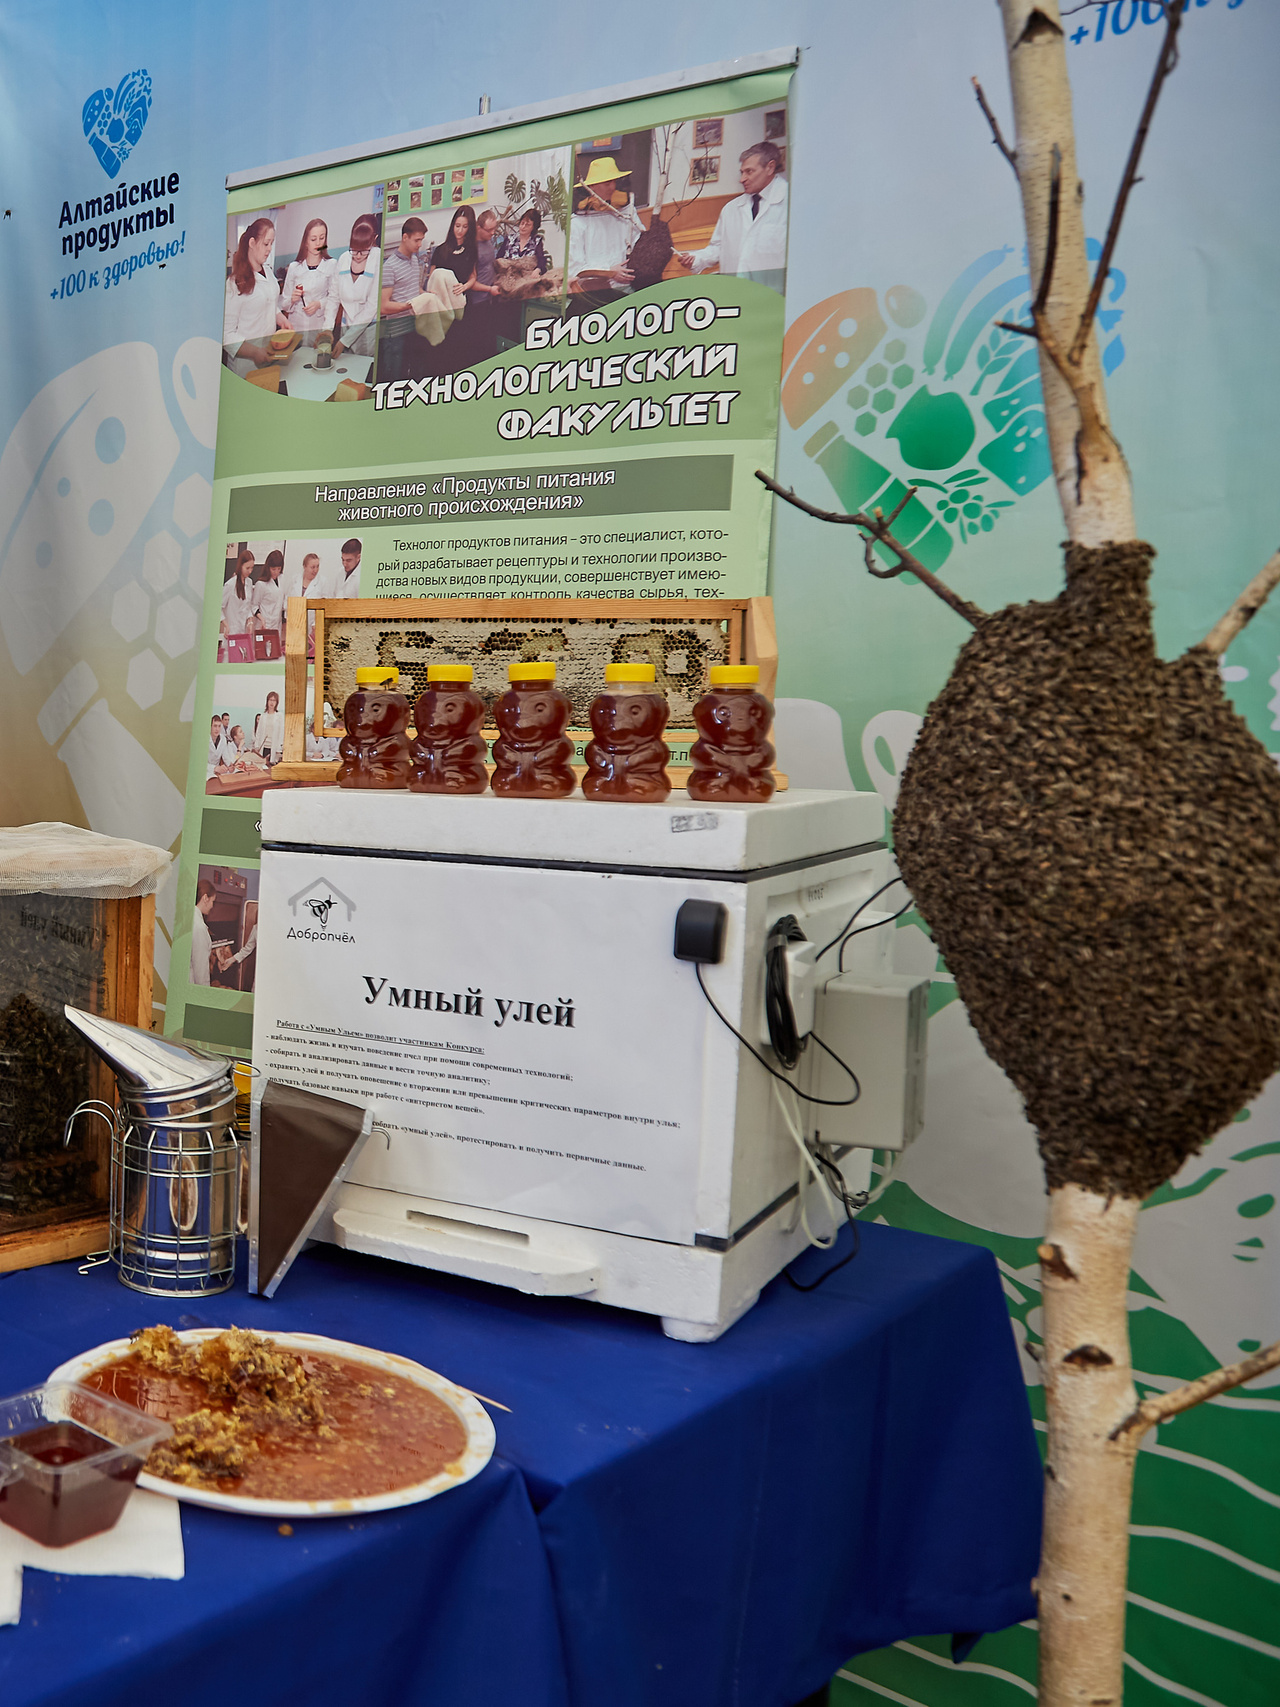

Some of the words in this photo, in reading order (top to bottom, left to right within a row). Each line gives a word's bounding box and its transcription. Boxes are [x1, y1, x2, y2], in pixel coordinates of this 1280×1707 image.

[58, 172, 180, 229] Алтайские
[62, 203, 175, 259] продукты
[50, 269, 87, 300] +100
[89, 270, 100, 289] к
[102, 230, 186, 290] здоровью!
[524, 297, 741, 352] БИОЛОГО-
[371, 343, 739, 412] ТЕХНОЛОГИЧЕСКИЙ
[496, 391, 741, 442] ФАКУЛЬТЕТ
[315, 482, 427, 504] Направление
[432, 473, 531, 497] «Продукты
[536, 469, 616, 490] питания
[337, 501, 424, 521] животного
[428, 494, 584, 518] происхождения»
[393, 539, 446, 551] Технолог
[448, 536, 511, 551] продуктов
[514, 535, 567, 547] питания
[579, 534, 601, 545] это
[604, 530, 686, 543] специалист,
[689, 529, 729, 540] кото-
[376, 576, 408, 589] дства
[410, 575, 447, 586] новых
[449, 574, 486, 586] видов
[488, 572, 561, 586] продукции,
[564, 570, 675, 584] совершенствует
[678, 569, 726, 580] имею-
[377, 559, 400, 573] рый
[402, 557, 494, 572] разрабатывает
[496, 554, 568, 569] рецептуры
[571, 557, 579, 565] и
[582, 553, 657, 565] технологии
[660, 551, 728, 565] произво-
[576, 588, 635, 599] качества
[694, 587, 725, 598] тех-
[287, 926, 356, 945] Добропчёл
[361, 975, 485, 1018] Умный
[493, 996, 577, 1029] улей
